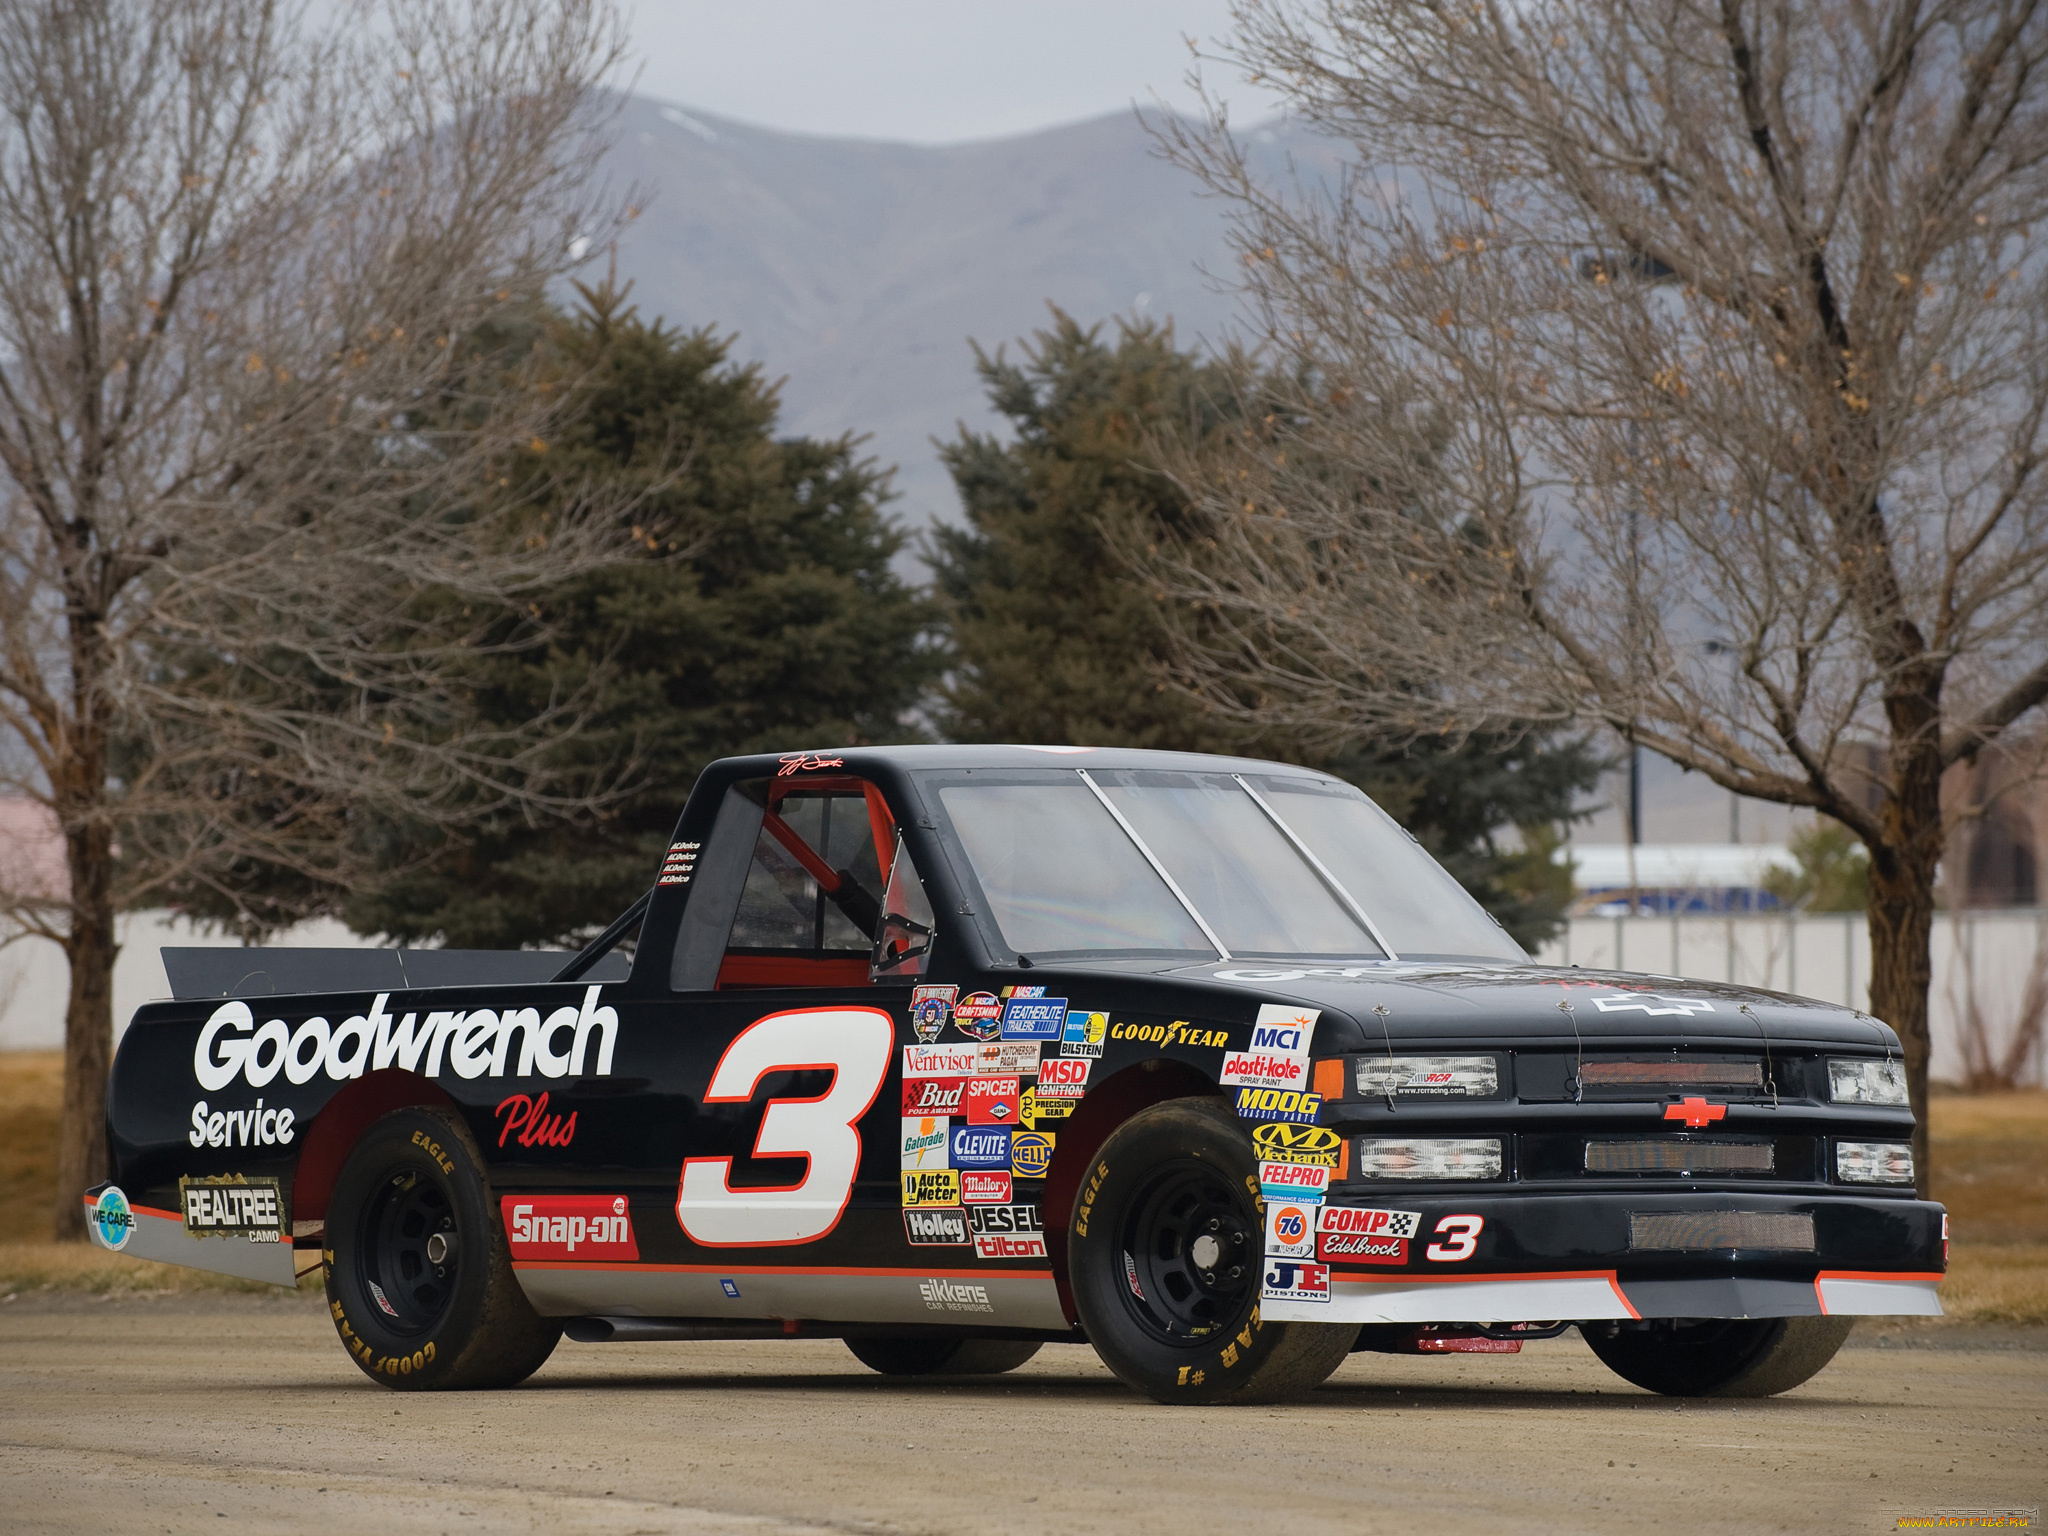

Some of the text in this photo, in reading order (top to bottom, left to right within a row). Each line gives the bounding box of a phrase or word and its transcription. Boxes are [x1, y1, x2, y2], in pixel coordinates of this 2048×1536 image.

[974, 997, 996, 1005] NASCAR
[1014, 986, 1044, 998] NASCAR
[955, 1018, 973, 1026] TRUCK
[957, 1006, 999, 1017] CRAFTSMAN
[1008, 1005, 1064, 1019] FEATHERLITE
[1007, 1020, 1036, 1031] TRAILERS
[1066, 1023, 1084, 1031] BILSTEIN
[194, 985, 620, 1091] Goodwrench
[1254, 1028, 1301, 1050] MCI
[905, 1047, 975, 1072] Ventvisor
[1061, 1043, 1103, 1056] BILSTEIN
[1000, 1056, 1018, 1067] PAGAN
[1039, 1060, 1087, 1083] MSD
[1224, 1054, 1301, 1079] plasti-kote
[1239, 1076, 1282, 1086] SPRAY PAINT
[1425, 1073, 1452, 1082] RCR
[917, 1082, 965, 1107] Bud
[968, 1080, 1016, 1097] SPICER
[1037, 1085, 1083, 1096] IGNITION
[1398, 1087, 1465, 1095] www.rcrracing.com
[1236, 1088, 1321, 1115] MOOG
[189, 1098, 295, 1148] Service
[495, 1091, 578, 1148] Plus
[1238, 1108, 1315, 1123] CHASSIS PARTS
[675, 1005, 895, 1248] 3
[411, 1130, 455, 1175] EAGLE
[904, 1132, 944, 1152] Gatorade
[954, 1129, 1007, 1155] CLEVITE
[1013, 1147, 1053, 1164] HELLA
[1252, 1141, 1338, 1167] Mechanix
[919, 1173, 950, 1187] Auto
[965, 1176, 1009, 1194] Mallory
[1262, 1164, 1325, 1187] FEL-PRO
[916, 1187, 957, 1201] Meter
[1076, 1160, 1110, 1238] EAGLE
[91, 1209, 106, 1223] WE
[186, 1189, 279, 1226] REALTREE
[512, 1204, 628, 1252] Snap-on
[909, 1213, 965, 1243] Holley
[970, 1207, 1042, 1232] JESEL
[1279, 1214, 1303, 1236] 76
[1322, 1208, 1389, 1233] COMP
[249, 1230, 280, 1243] CAMO
[977, 1236, 1044, 1256] tilton
[1323, 1234, 1401, 1257] Edelbrock
[1426, 1213, 1485, 1262] 3
[1265, 1262, 1328, 1291] JE
[919, 1279, 990, 1303] sikkens
[1265, 1289, 1328, 1298] PISTONS
[926, 1302, 994, 1313] CAR REFINISHES
[1177, 1365, 1205, 1386] #1
